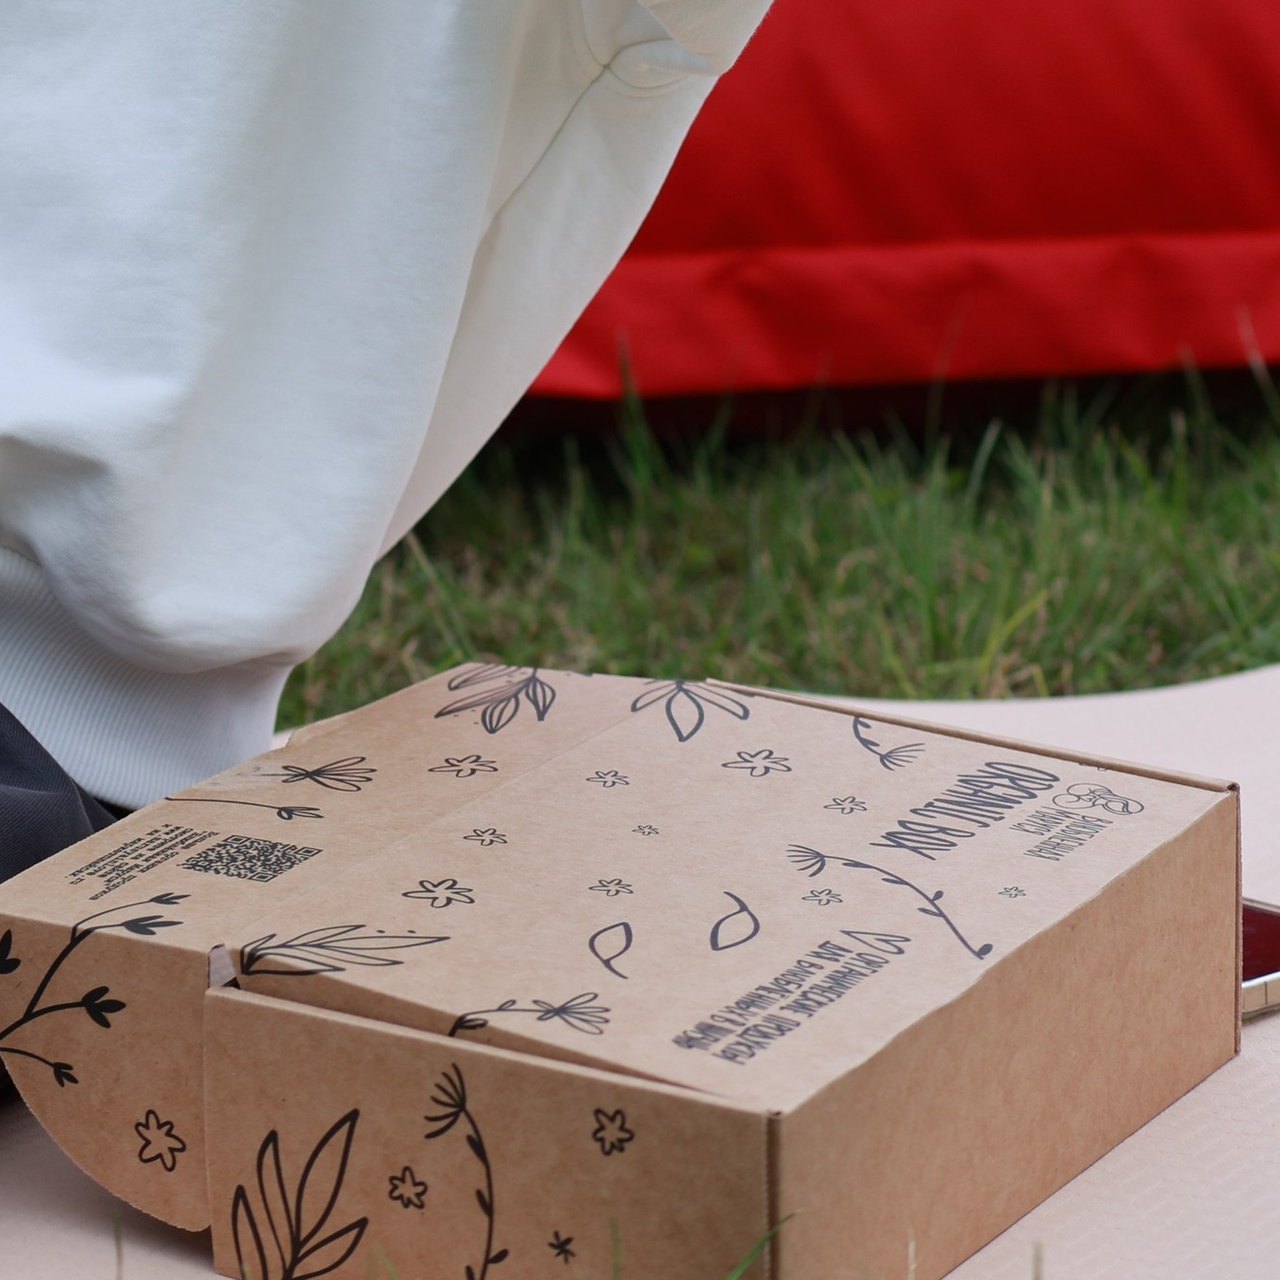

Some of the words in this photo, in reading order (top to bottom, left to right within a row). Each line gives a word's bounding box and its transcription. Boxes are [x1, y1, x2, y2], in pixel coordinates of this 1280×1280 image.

[910, 762, 1060, 828] ORGANIC
[869, 820, 976, 860] BOX
[804, 940, 854, 963] ДЛЯ
[779, 951, 890, 1018] ОРГАНИЧЕСКИЕ
